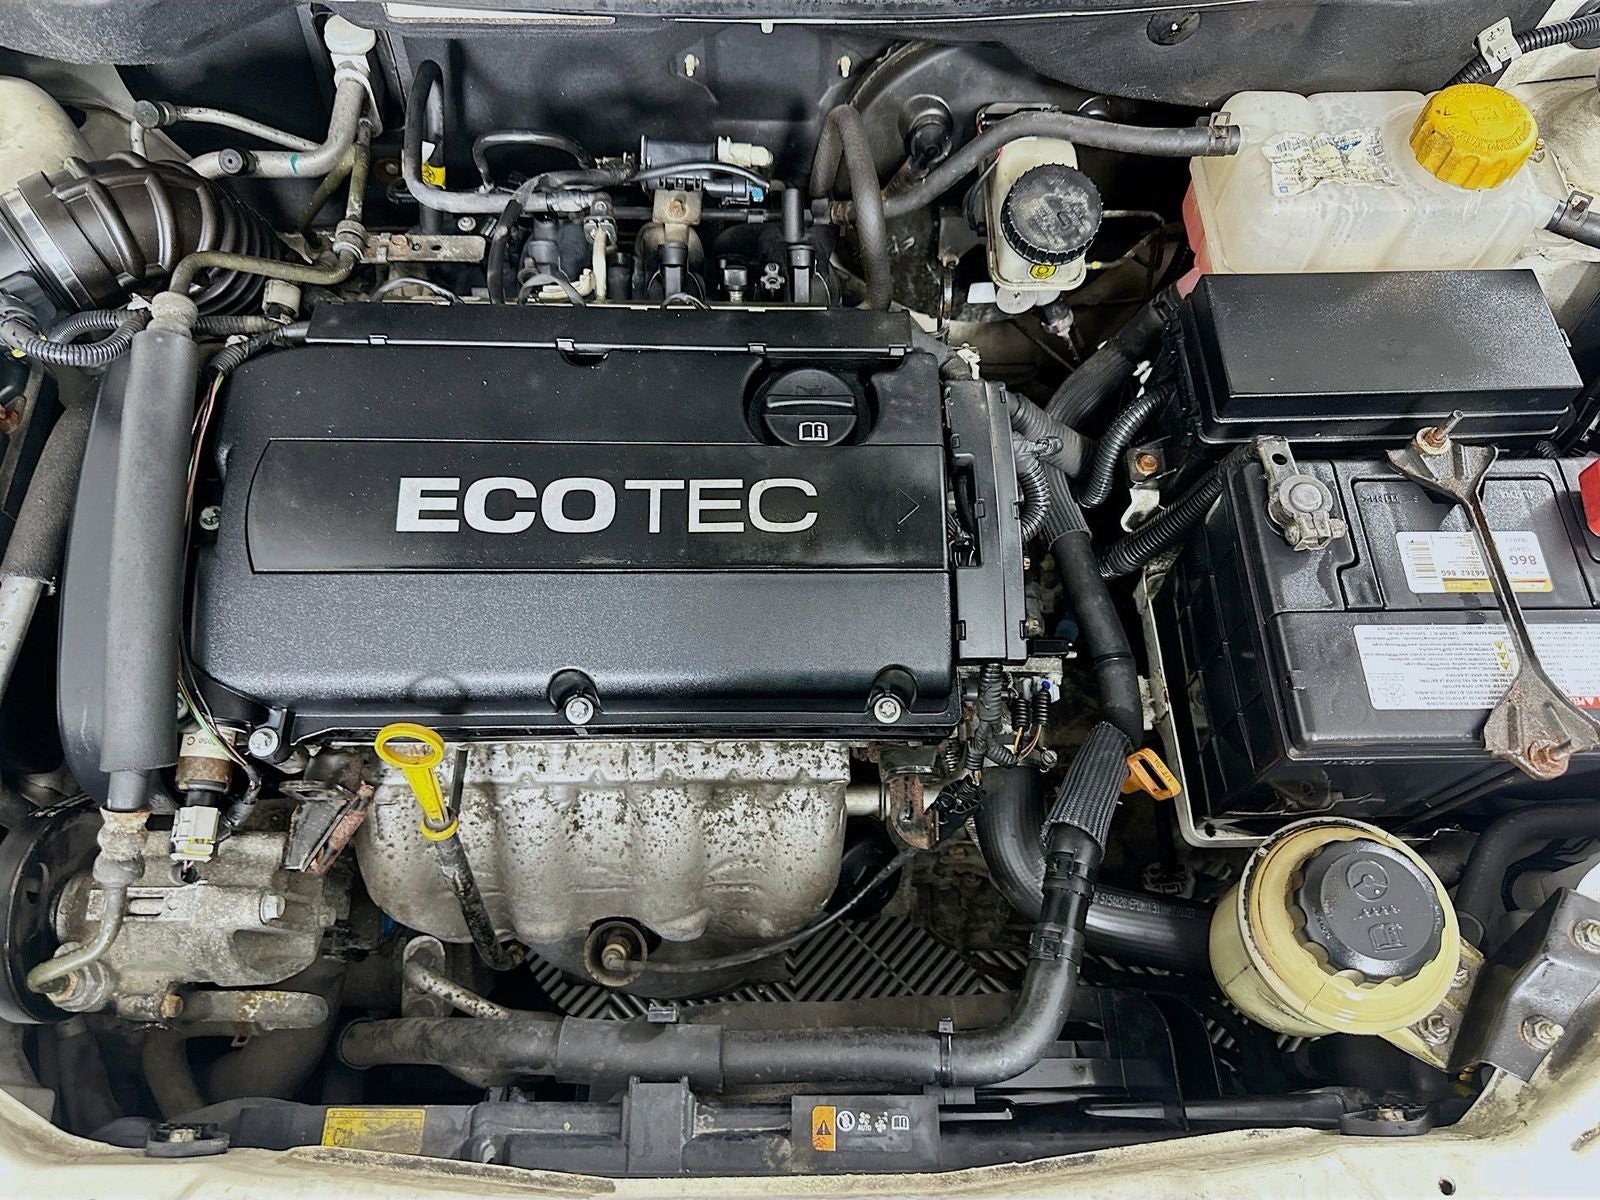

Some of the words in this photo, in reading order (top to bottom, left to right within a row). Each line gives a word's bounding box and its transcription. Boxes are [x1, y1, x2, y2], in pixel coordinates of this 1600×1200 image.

[396, 477, 818, 533] ECOTEC
[1509, 555, 1537, 566] 86G
[186, 736, 196, 746] C
